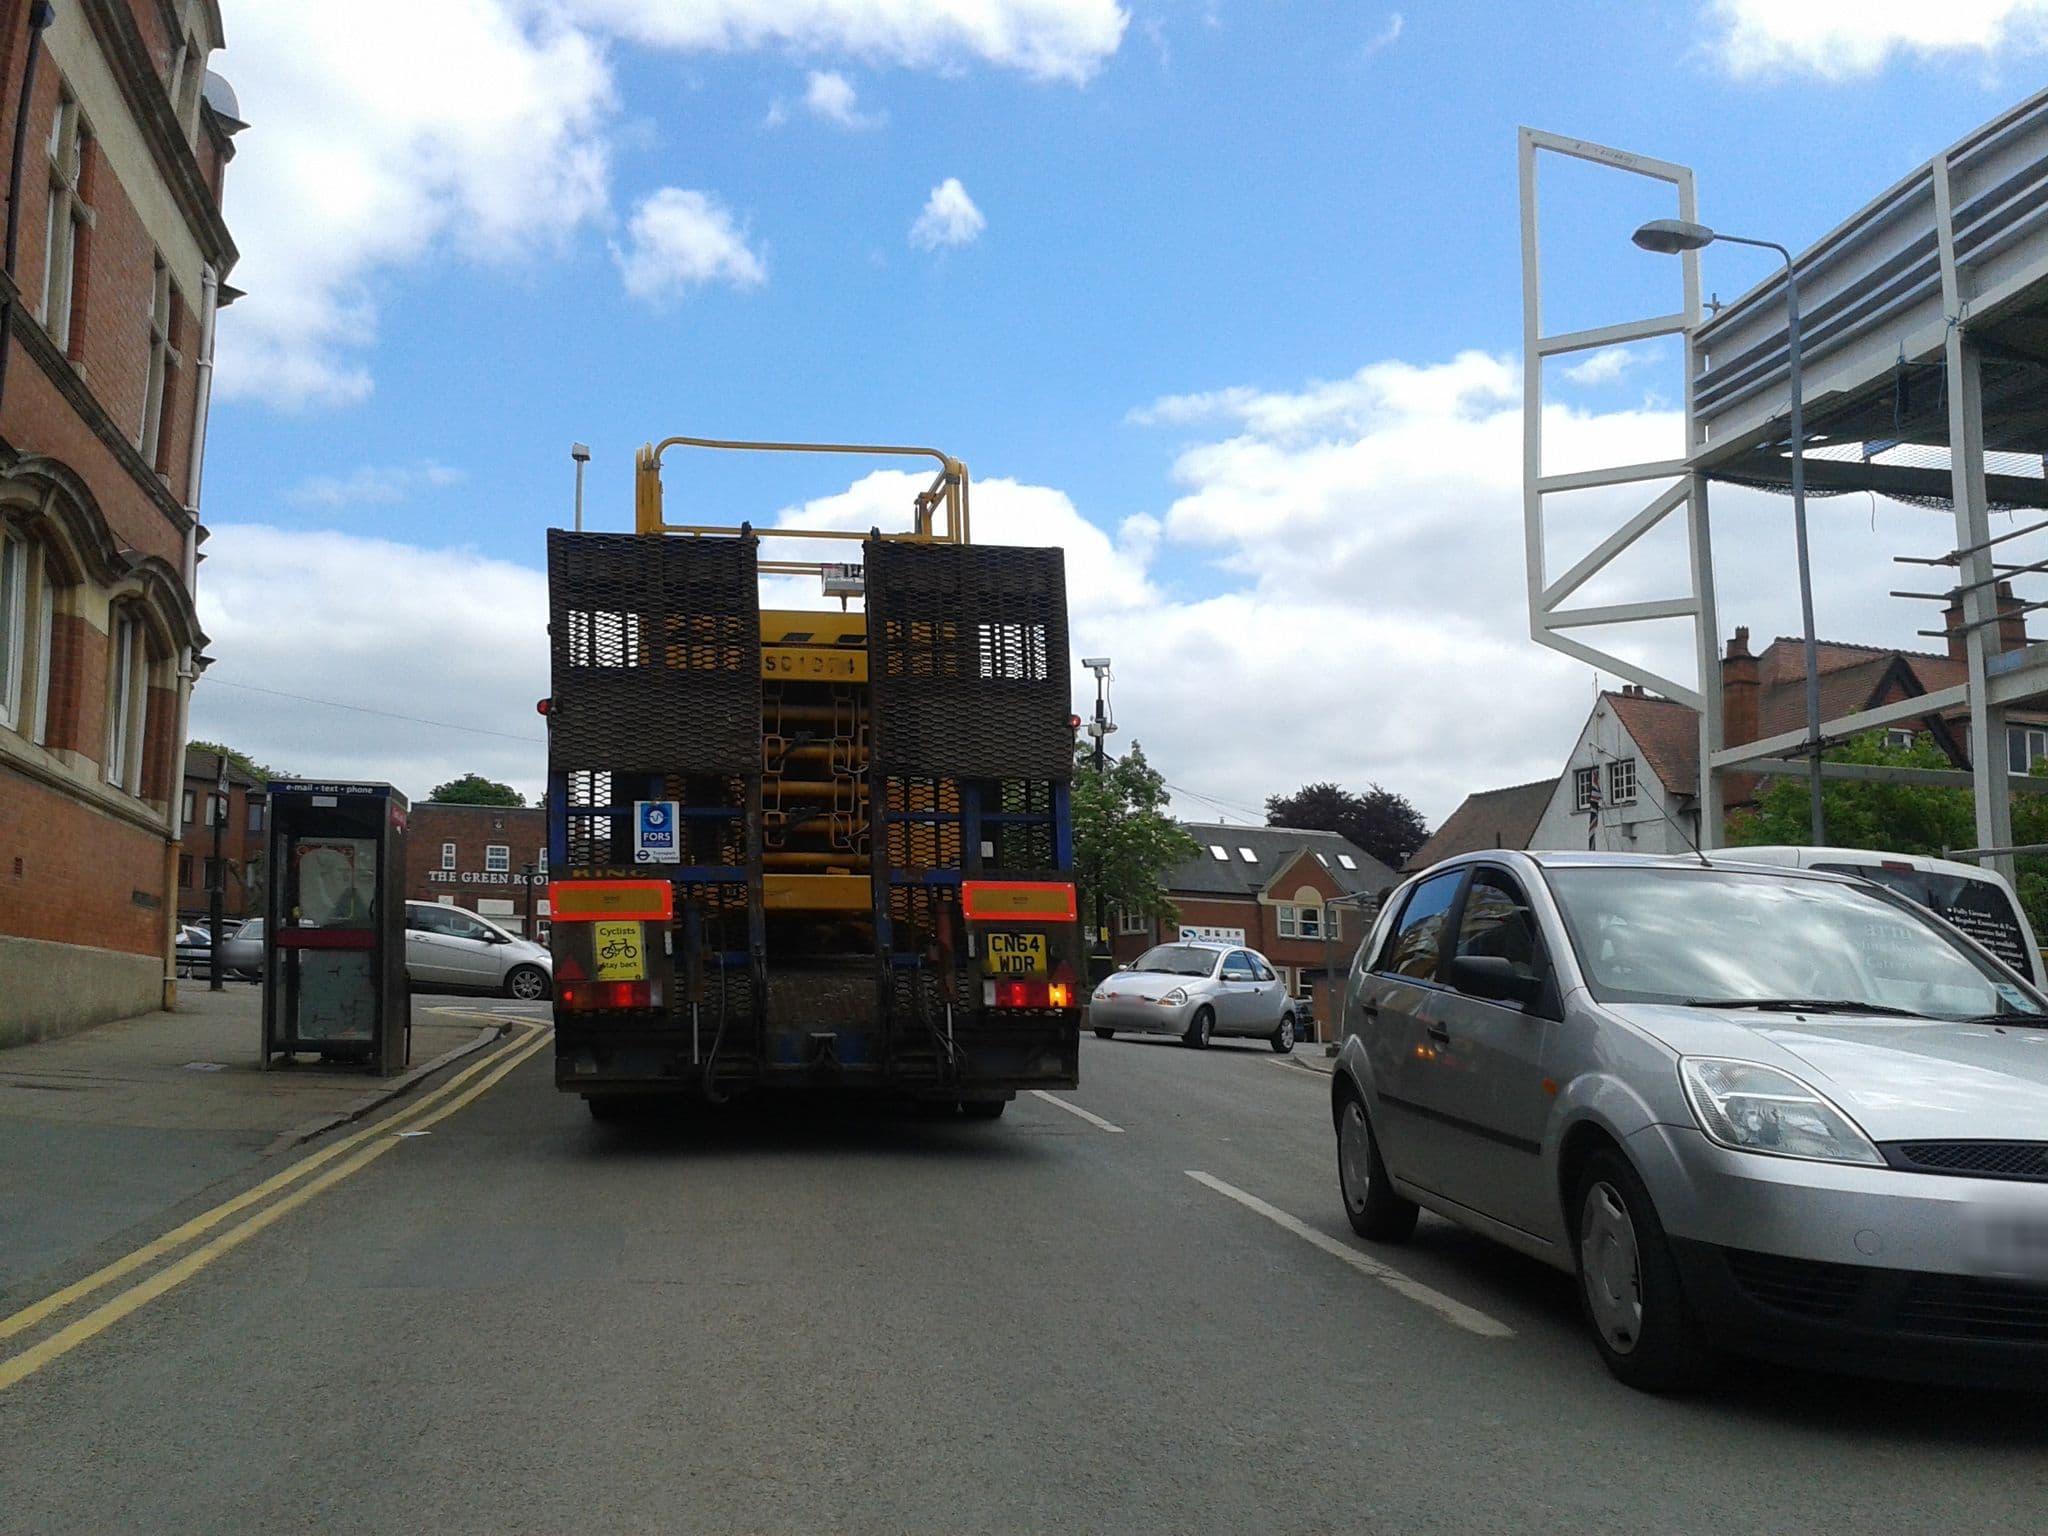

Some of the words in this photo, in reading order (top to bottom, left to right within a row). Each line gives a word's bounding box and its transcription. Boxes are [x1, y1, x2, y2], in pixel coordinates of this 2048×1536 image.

[346, 786, 373, 794] phone
[643, 832, 671, 841] FORS
[428, 871, 457, 882] THE
[461, 872, 509, 884] GREEN
[600, 927, 636, 937] Cyclists
[992, 936, 1040, 952] CN64
[999, 955, 1036, 972] WDR
